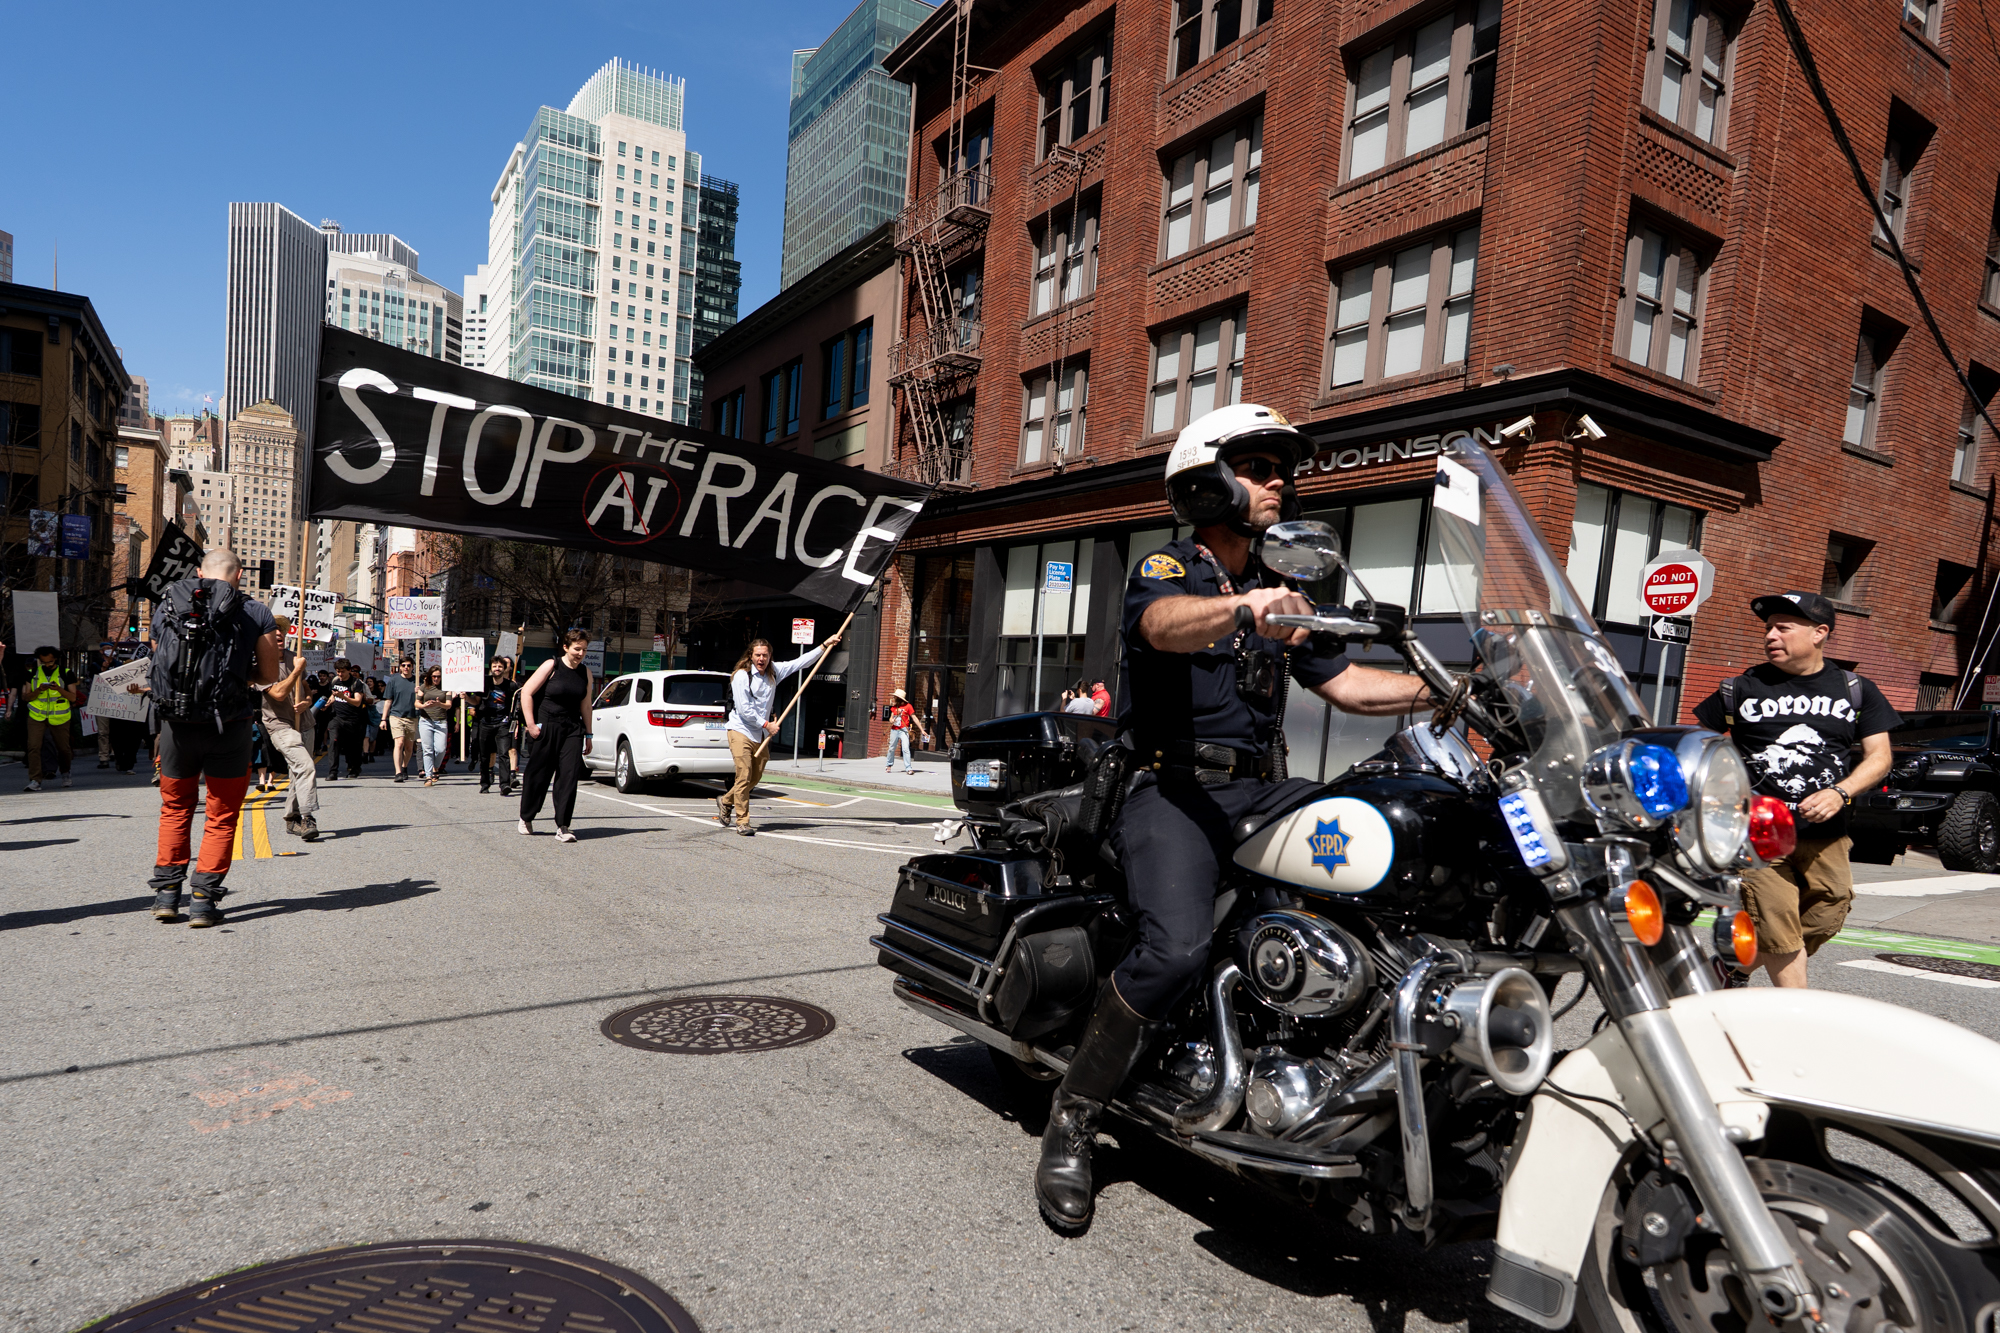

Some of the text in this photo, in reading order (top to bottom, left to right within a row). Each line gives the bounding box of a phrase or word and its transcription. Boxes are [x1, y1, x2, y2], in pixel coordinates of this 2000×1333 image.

[1180, 446, 1197, 460] 1593
[1319, 423, 1504, 472] JOHNSON
[1177, 457, 1200, 469] SFPD
[324, 366, 923, 586] STOP THE AI RACE
[1652, 571, 1693, 583] DO NOT
[271, 587, 287, 598] IF
[284, 601, 323, 612] BULDS
[389, 597, 417, 611] CEOs
[1651, 595, 1687, 606] ENTER
[390, 627, 412, 636] SPEED
[1662, 623, 1689, 637] ONE WAY
[444, 640, 484, 658] GROWN
[447, 655, 472, 666] NOT
[582, 660, 601, 668] Parking
[824, 674, 841, 682] COFFEE
[1986, 675, 1996, 683] NO
[97, 693, 140, 705] LEADS TO
[100, 701, 128, 710] HUMAN
[89, 706, 138, 719] STUPIDITY
[1937, 754, 1977, 763] HIGH-TIDE
[933, 885, 967, 911] POLICE
